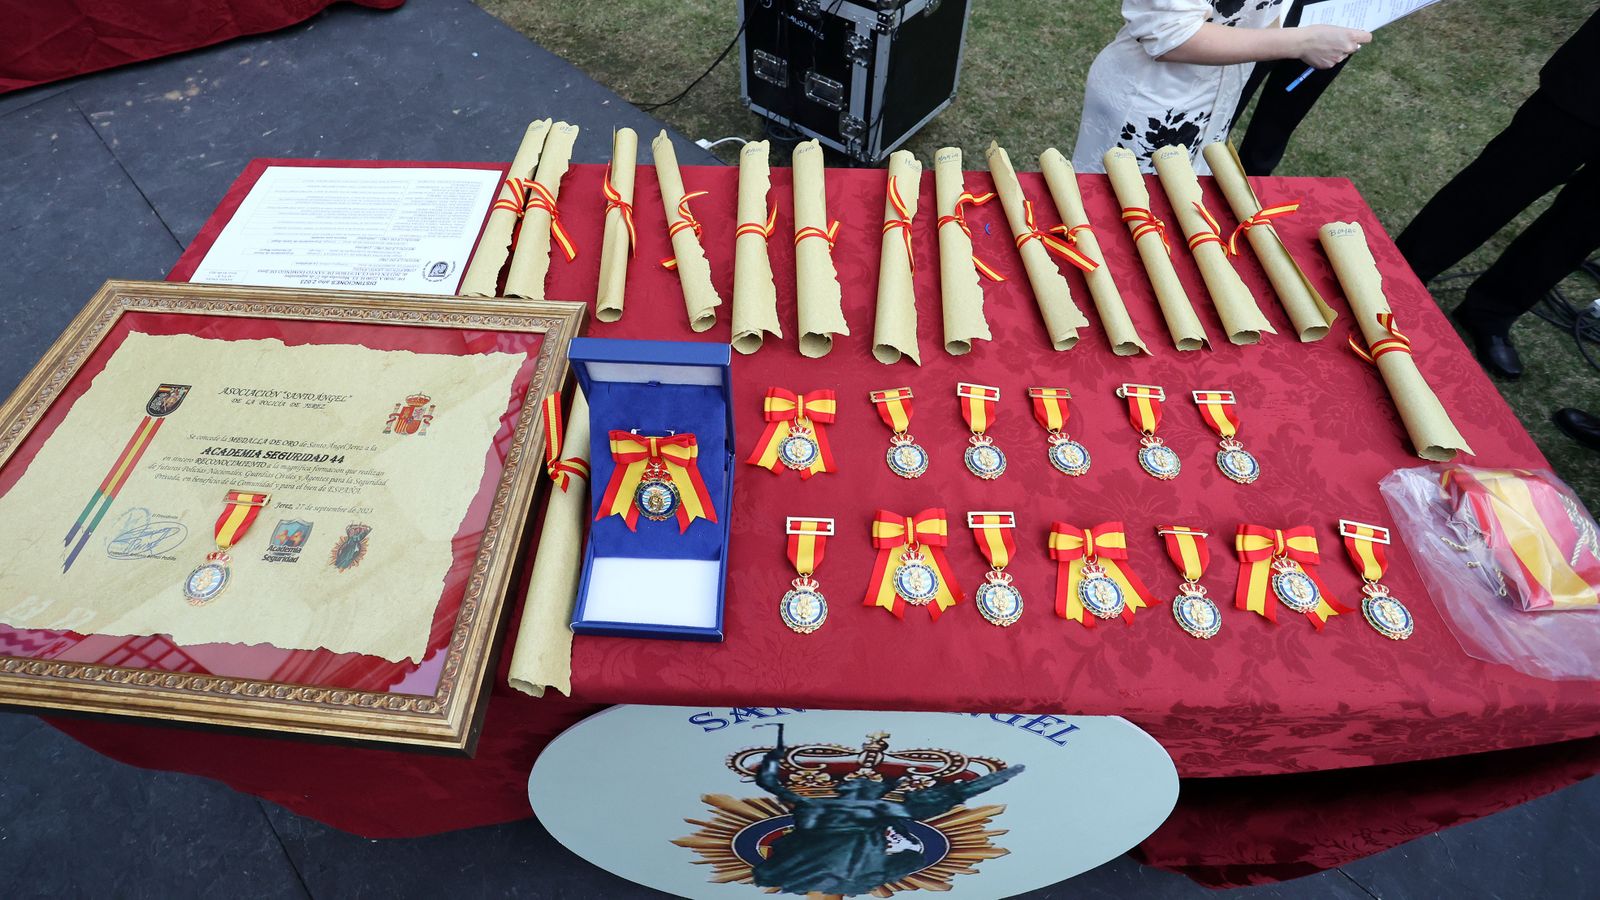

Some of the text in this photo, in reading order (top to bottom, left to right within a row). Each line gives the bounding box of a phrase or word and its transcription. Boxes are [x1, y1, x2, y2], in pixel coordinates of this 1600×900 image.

[218, 386, 282, 398] ASOCIACIÓN
[229, 436, 269, 446] MEDALLA
[281, 440, 300, 448] ORO
[200, 446, 345, 464] ACADEMIA SEGURIDAD 44
[194, 458, 268, 469] RECONOCIMIENTO
[265, 545, 302, 554] Academia
[261, 554, 300, 564] Seguridad
